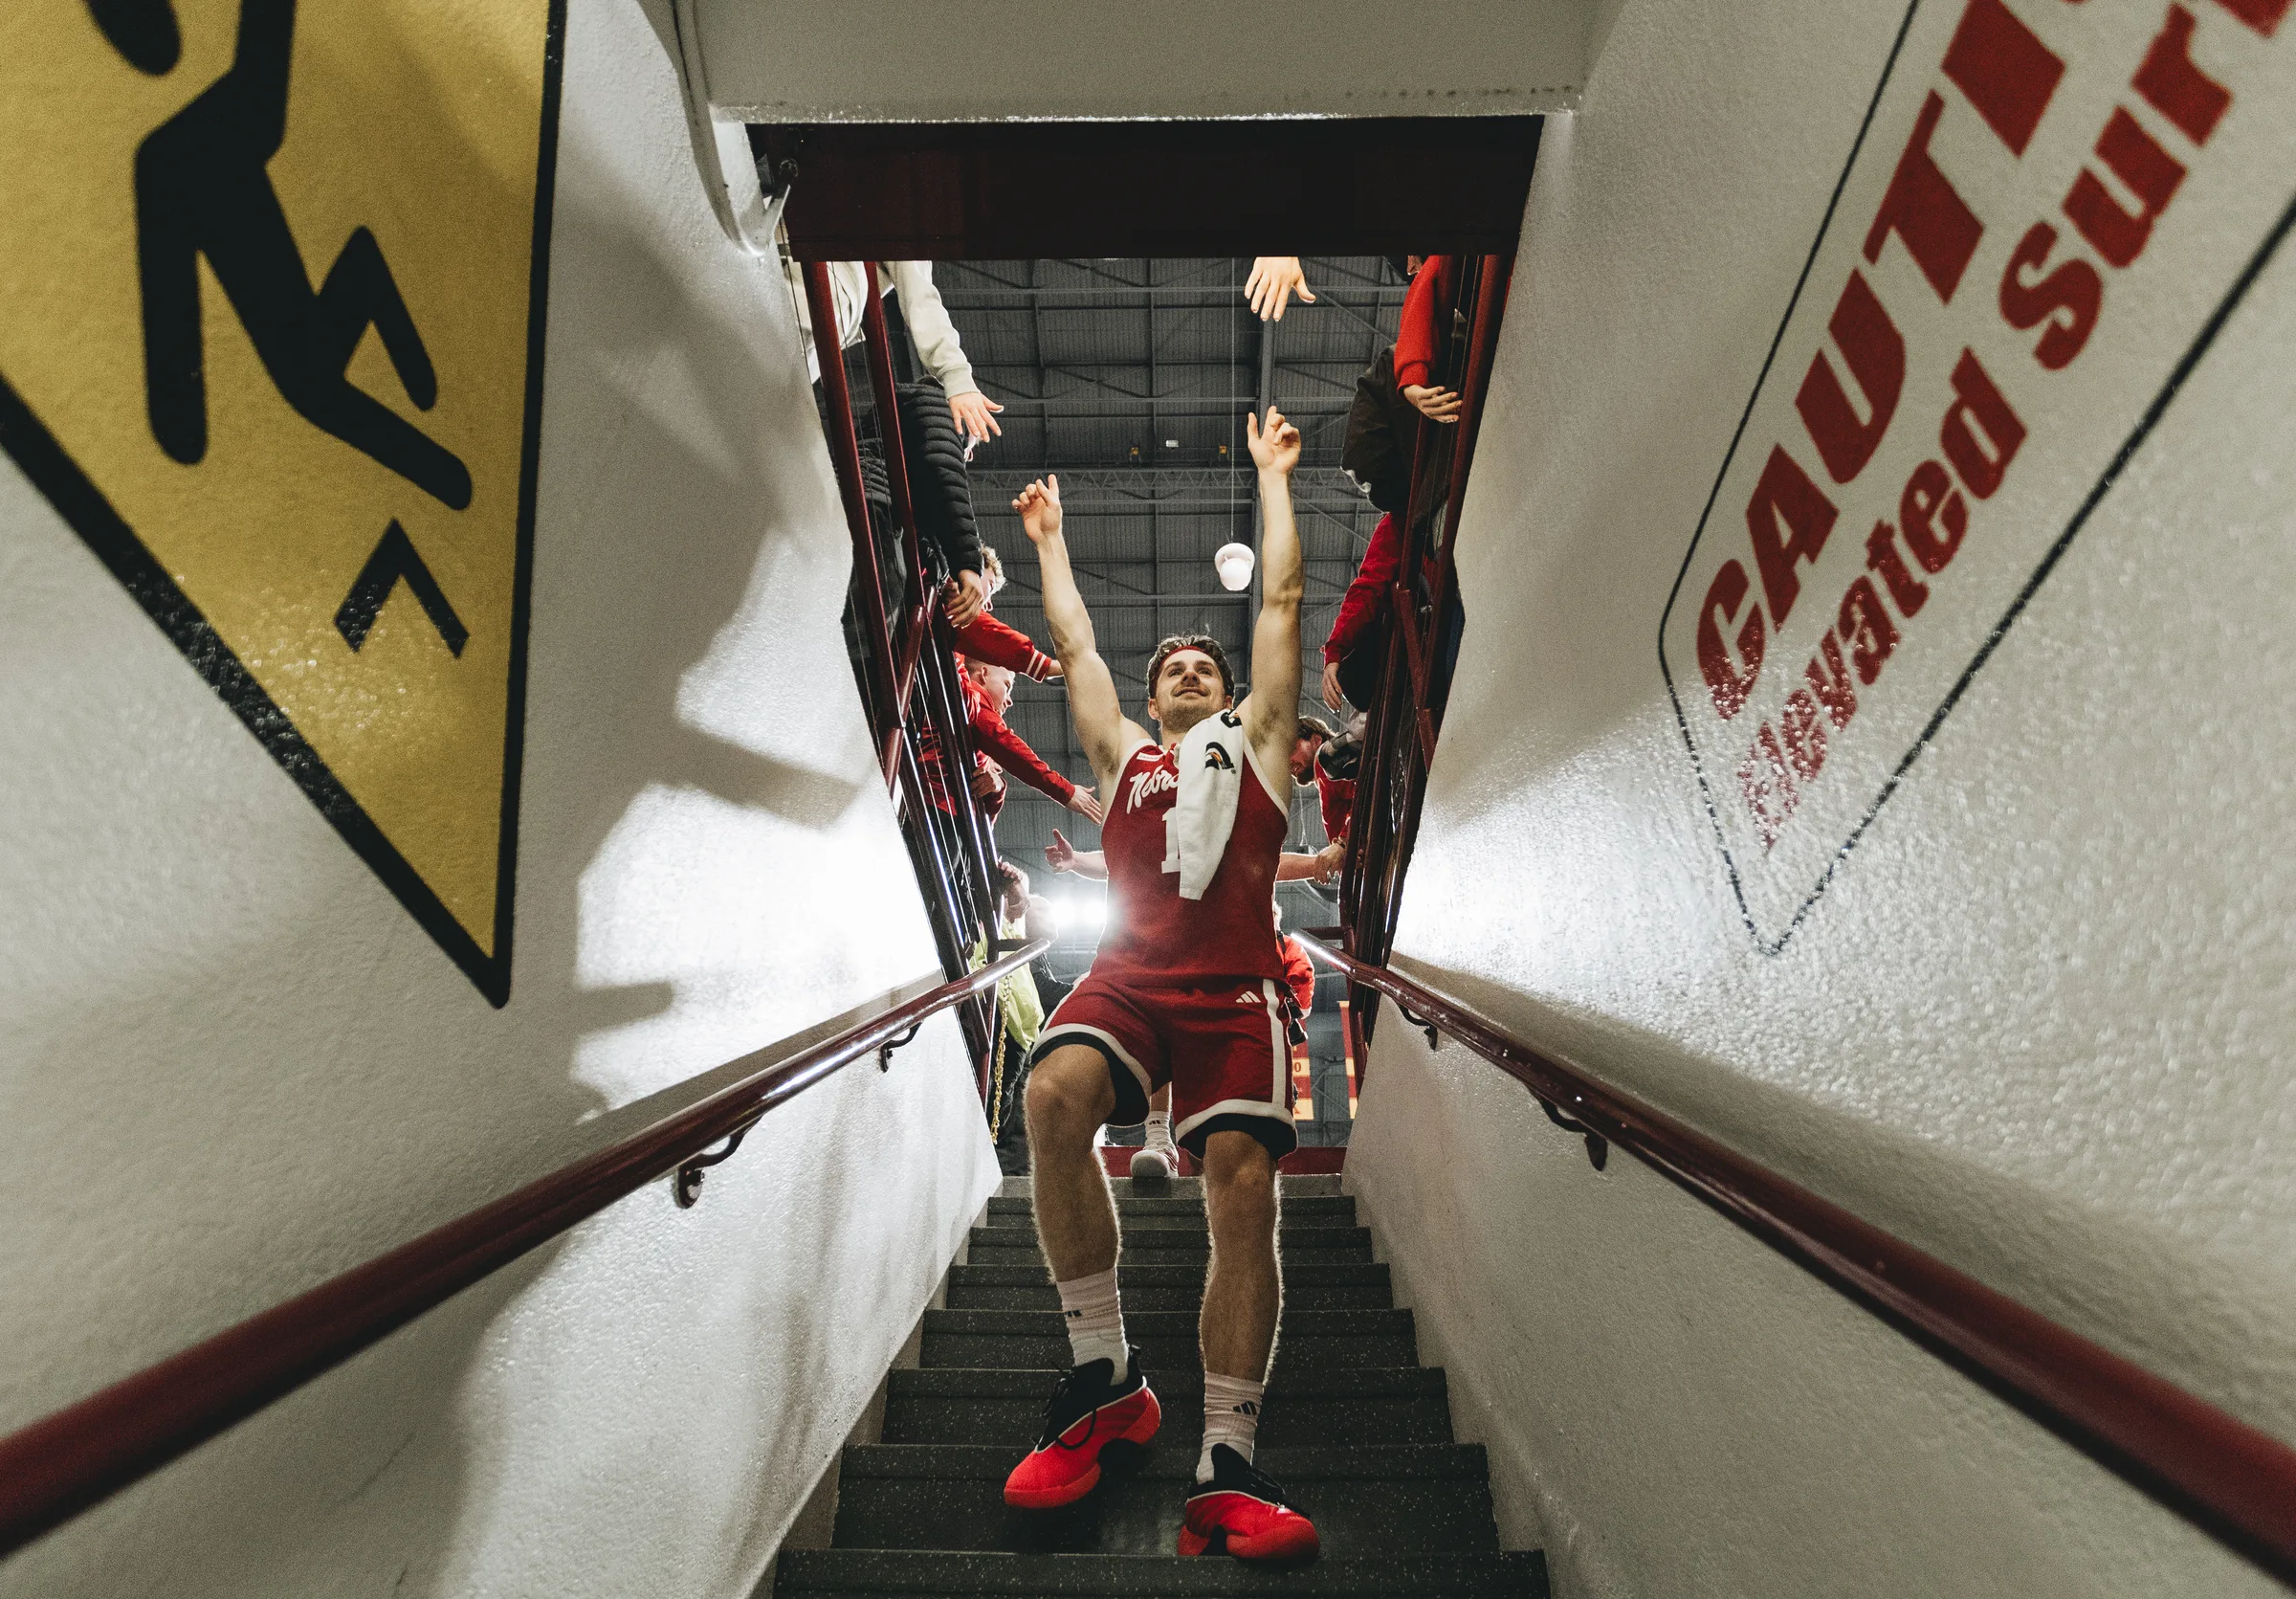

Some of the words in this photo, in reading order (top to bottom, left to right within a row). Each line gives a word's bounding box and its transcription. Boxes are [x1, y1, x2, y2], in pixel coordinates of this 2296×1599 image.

[1697, 0, 2086, 721] CAUTI
[1737, 347, 2027, 850] Elevated
[1998, 0, 2295, 371] Sur
